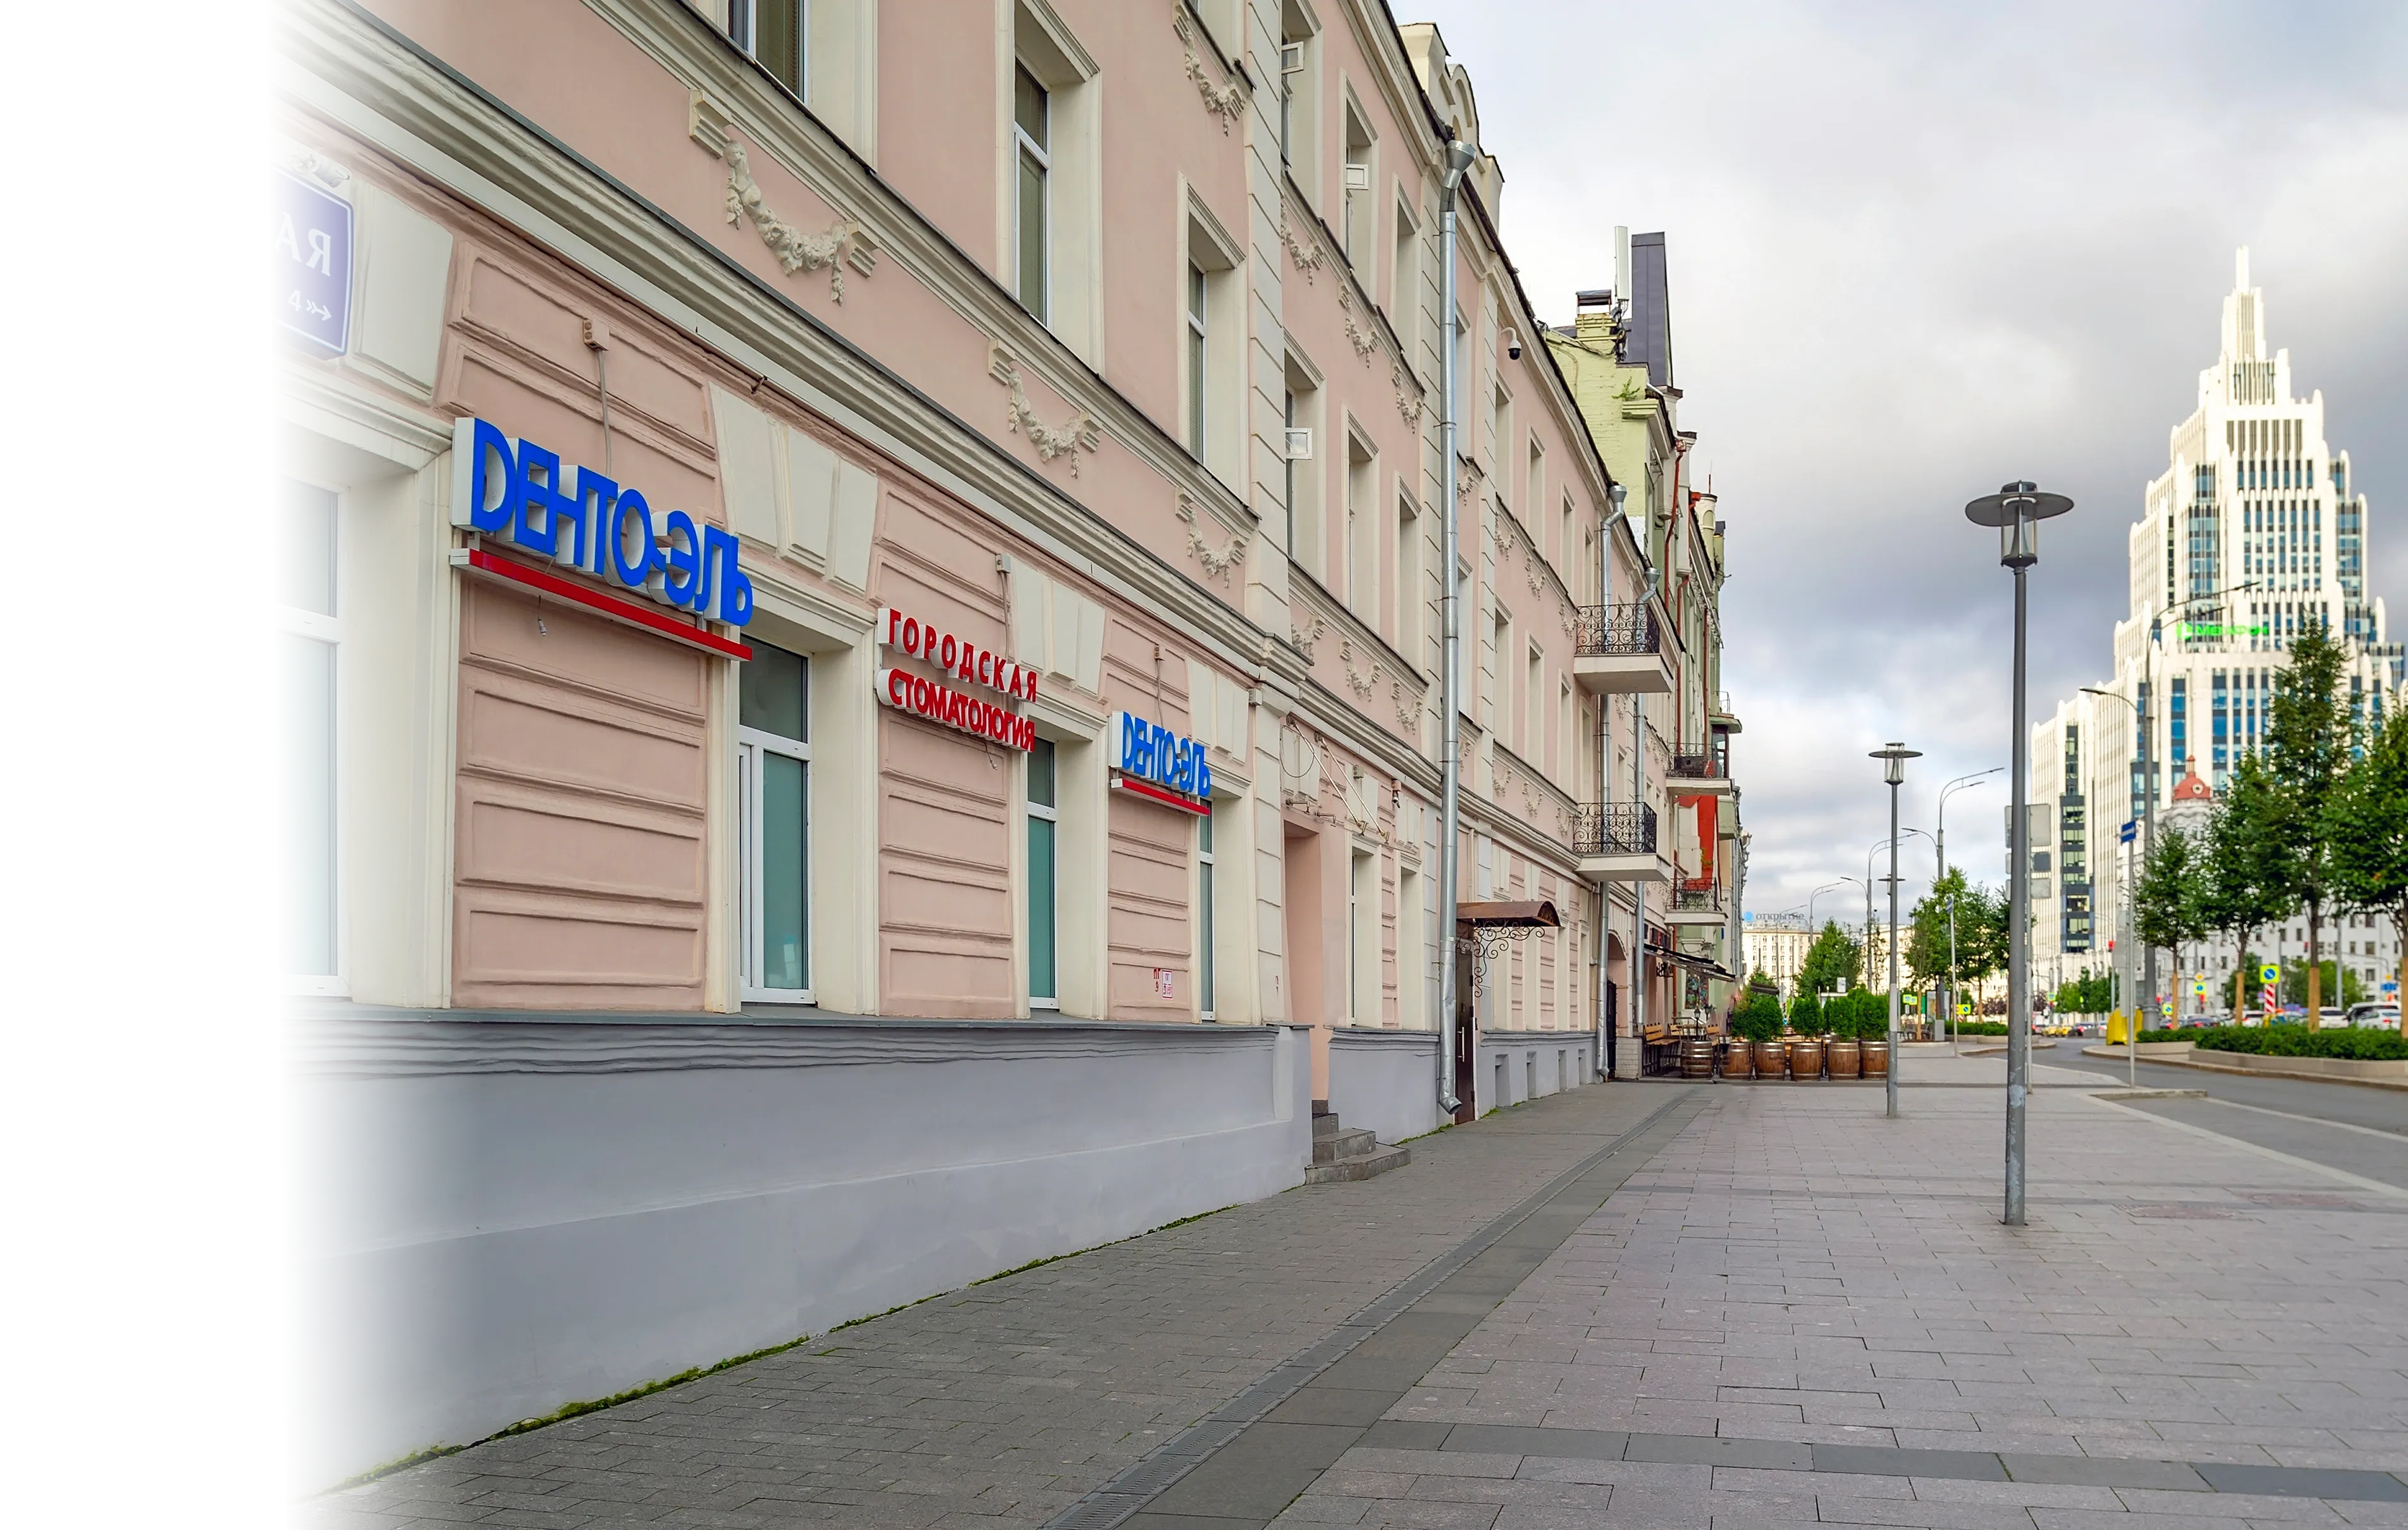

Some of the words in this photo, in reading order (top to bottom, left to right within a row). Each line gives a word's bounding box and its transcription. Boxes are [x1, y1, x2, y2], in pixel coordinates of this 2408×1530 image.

[288, 289, 302, 312] 4
[888, 608, 1038, 703] ГОРОДСКАЯ
[888, 669, 1036, 753] СТОМАТОЛОГИЯ
